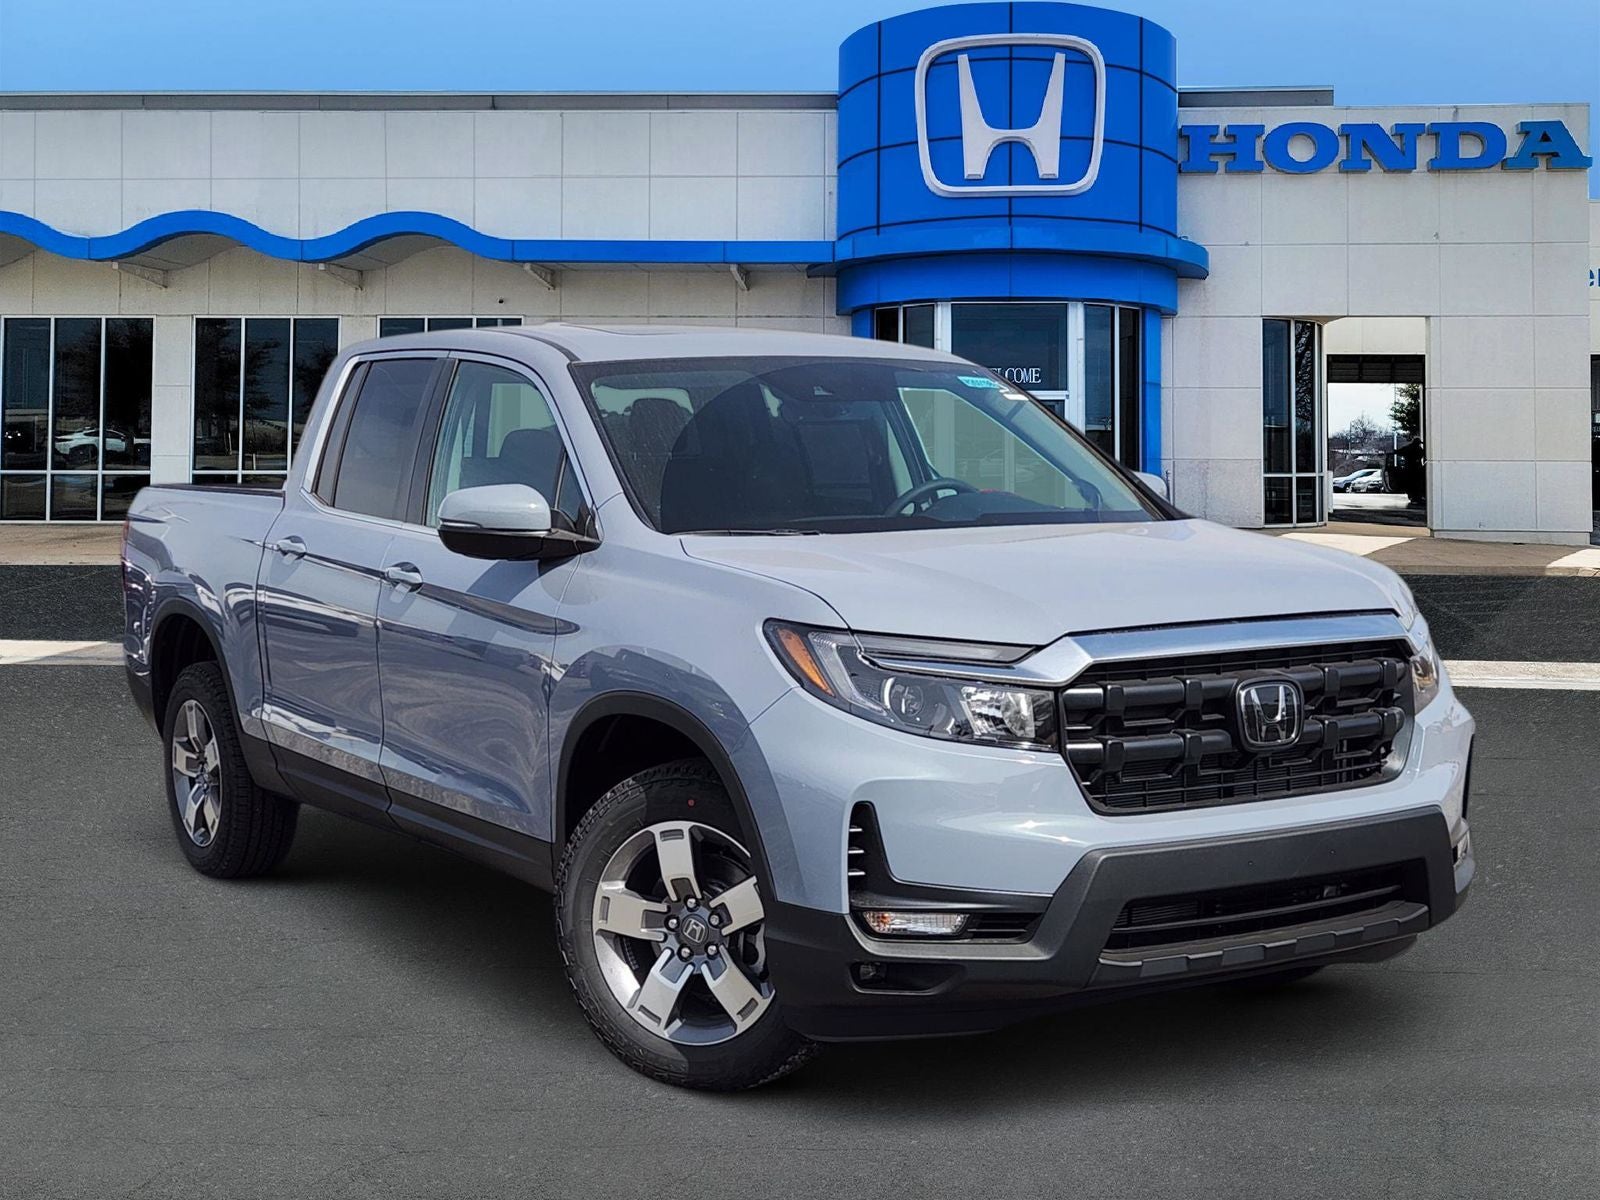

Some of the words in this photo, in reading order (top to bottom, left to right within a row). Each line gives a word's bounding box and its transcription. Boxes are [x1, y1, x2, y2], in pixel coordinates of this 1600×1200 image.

[957, 51, 1066, 180] H
[1178, 120, 1593, 175] HONDA
[989, 367, 1042, 384] COME
